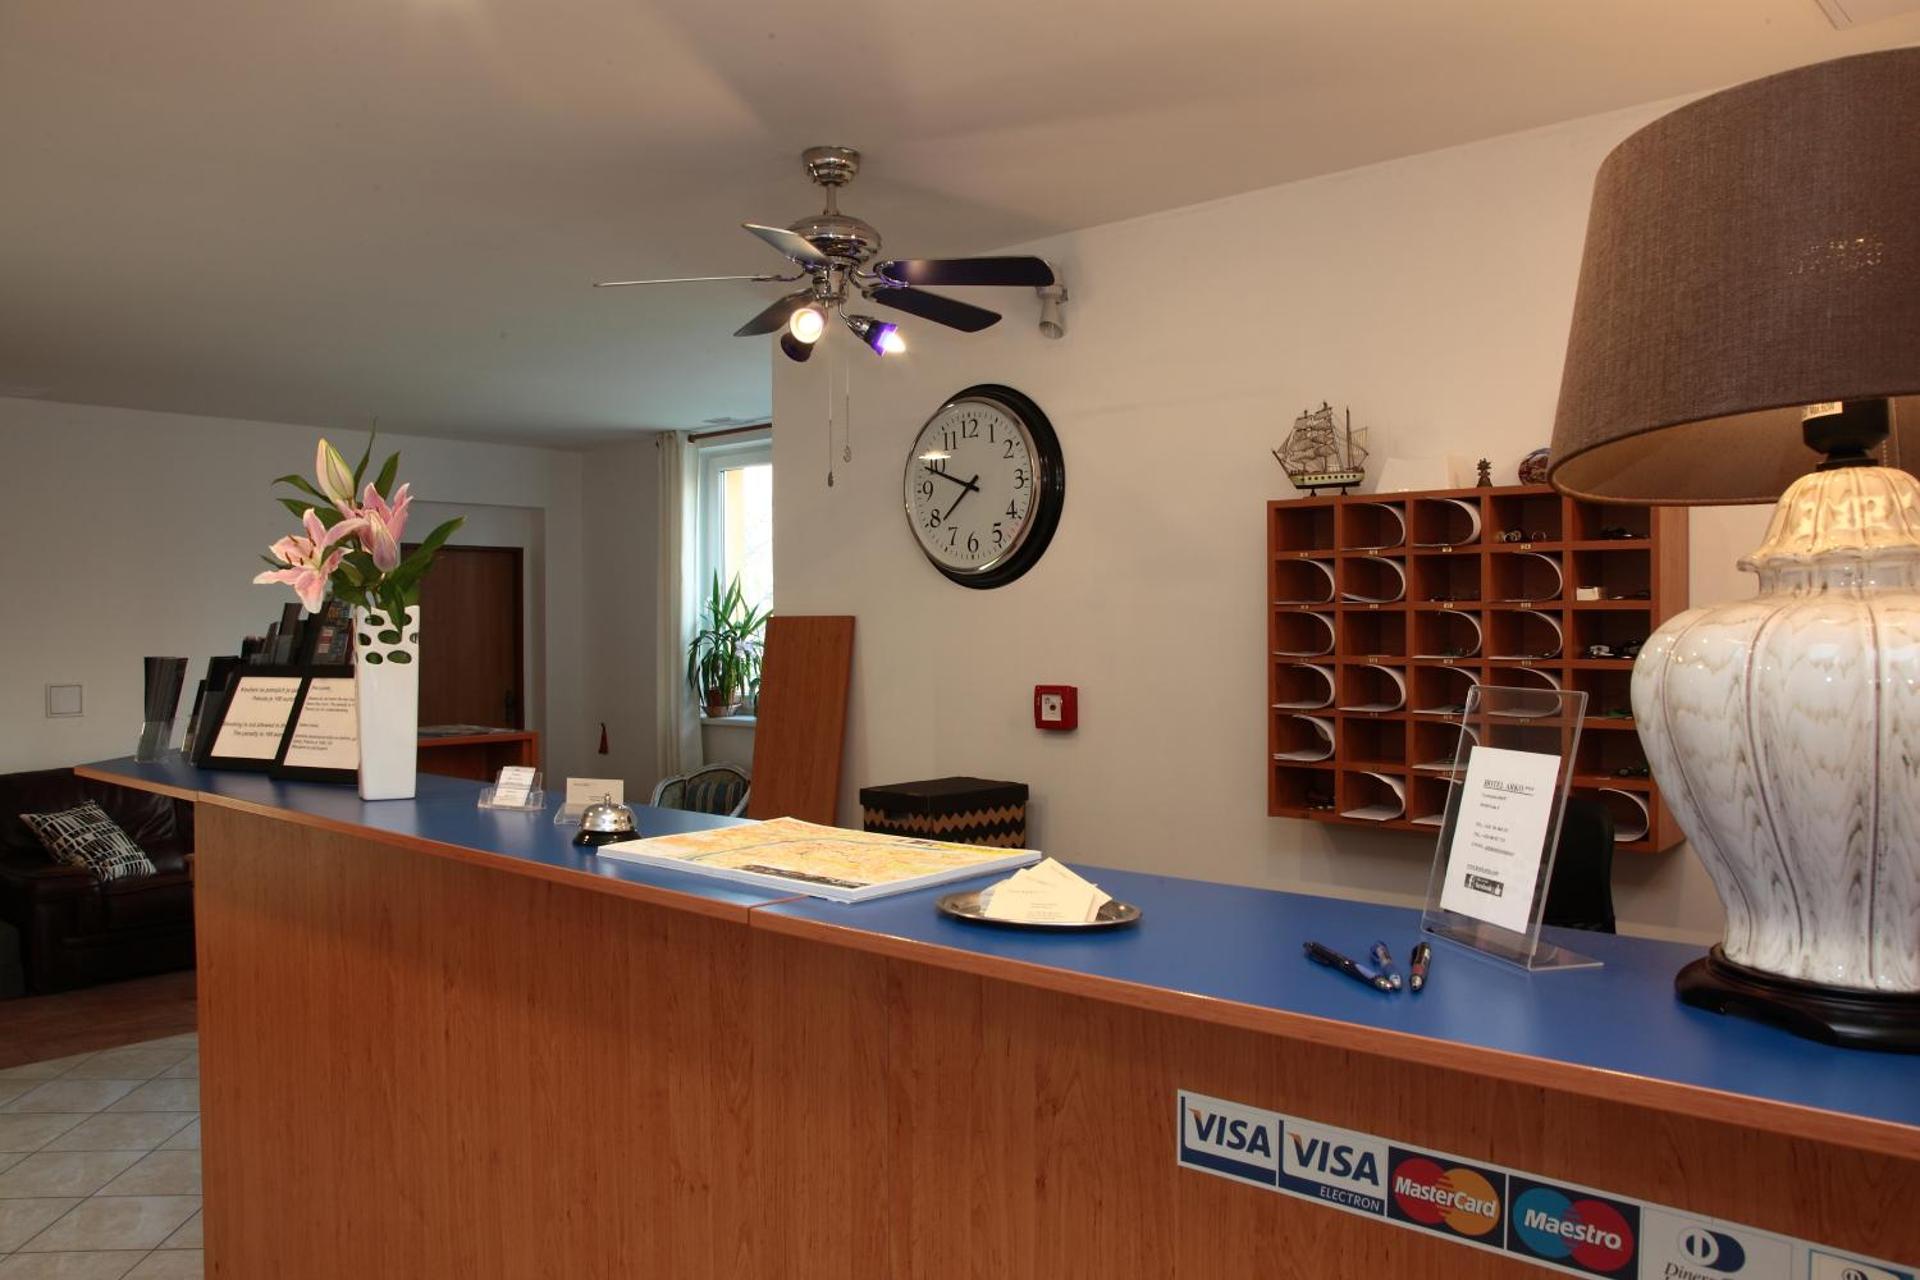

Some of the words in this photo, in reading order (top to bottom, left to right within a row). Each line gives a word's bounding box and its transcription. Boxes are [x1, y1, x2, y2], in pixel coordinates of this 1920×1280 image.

[961, 419, 979, 439] 12
[988, 423, 995, 443] 1
[943, 431, 958, 451] 11
[1003, 439, 1015, 459] 2
[1014, 469, 1025, 489] 3
[922, 480, 934, 502] 9
[929, 508, 942, 528] 8
[1005, 499, 1018, 519] 4
[948, 526, 959, 546] 7
[967, 531, 979, 553] 6
[992, 522, 1003, 543] 5
[1188, 1107, 1272, 1158] VISA
[1287, 1132, 1380, 1186] VISA
[1319, 1185, 1381, 1212] ELECTRON
[1394, 1175, 1497, 1218] MasterCard
[1523, 1208, 1623, 1250] Maestro
